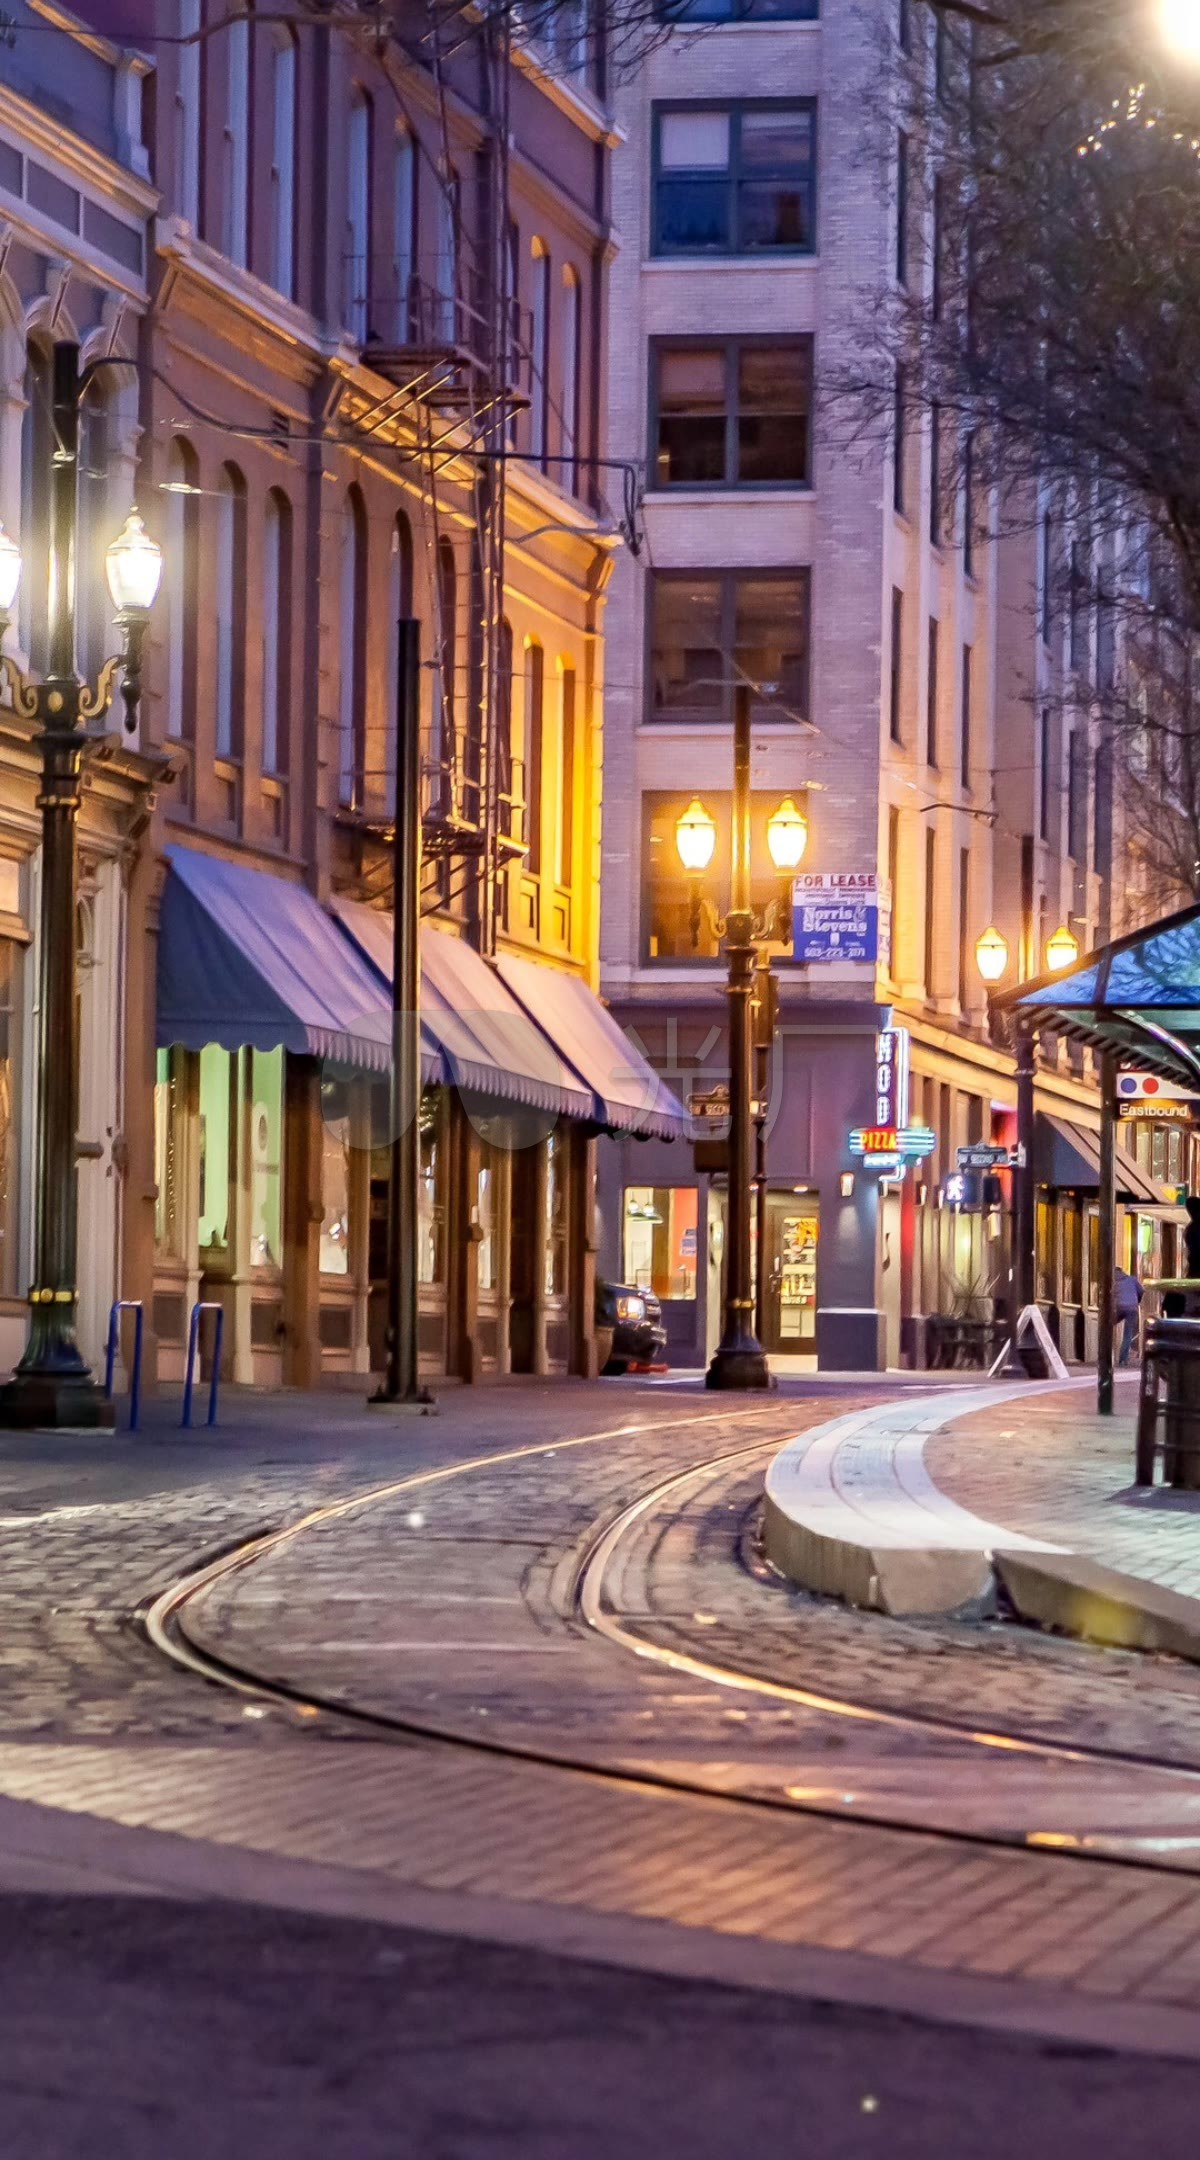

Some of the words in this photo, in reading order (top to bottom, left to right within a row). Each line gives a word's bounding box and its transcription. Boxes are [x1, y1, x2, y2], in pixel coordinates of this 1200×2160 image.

[795, 875, 823, 887] FOR
[830, 874, 876, 887] LEASE
[803, 906, 853, 920] Norris
[803, 920, 868, 933] Stevens
[1119, 1103, 1188, 1117] Eastbound
[860, 1131, 897, 1150] PIZZA
